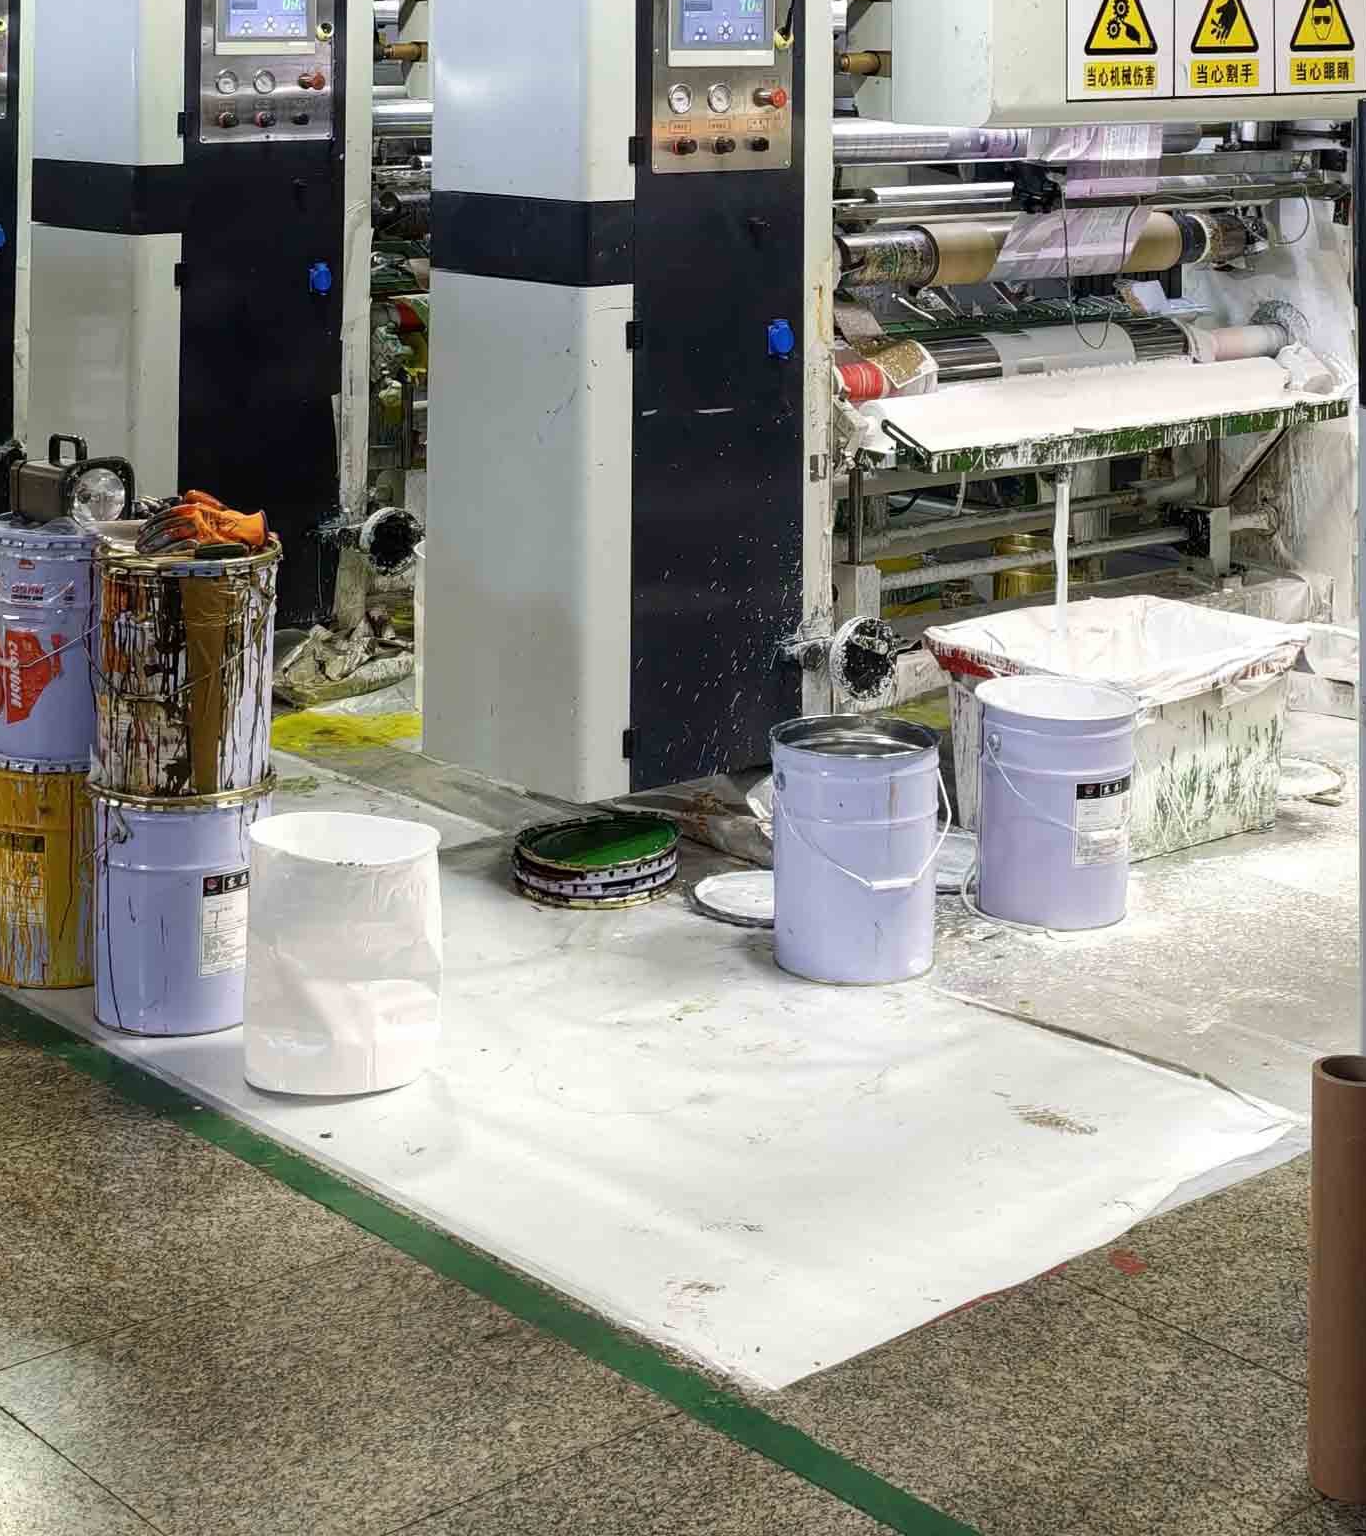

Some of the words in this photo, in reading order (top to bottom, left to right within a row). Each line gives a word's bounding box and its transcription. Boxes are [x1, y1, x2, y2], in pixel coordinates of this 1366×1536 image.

[1086, 64, 1156, 87] 当心机械伤害
[1195, 63, 1254, 84] 当心割手
[1295, 61, 1350, 81] 当心眼睛
